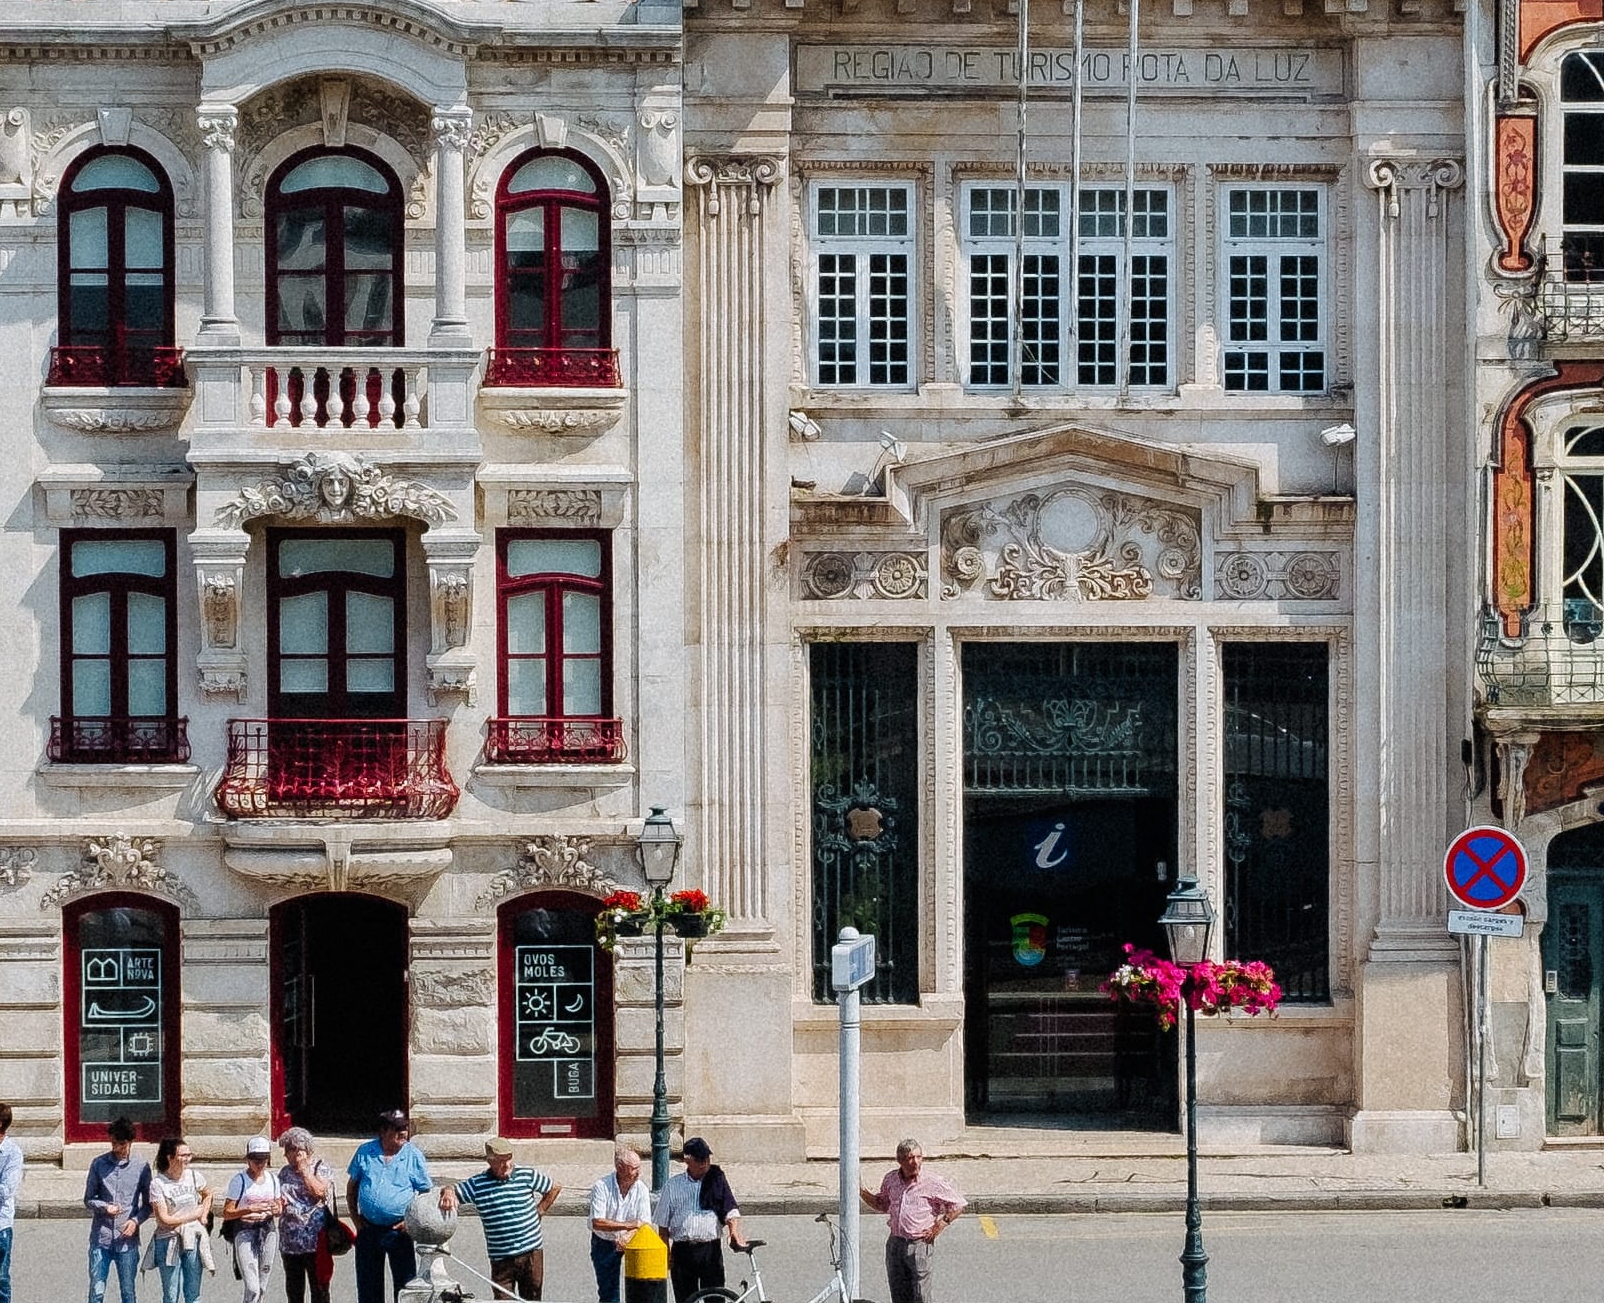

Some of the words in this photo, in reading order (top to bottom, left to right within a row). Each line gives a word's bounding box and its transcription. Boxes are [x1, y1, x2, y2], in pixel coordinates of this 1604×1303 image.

[945, 50, 981, 81] DE
[1204, 52, 1242, 83] DA
[1254, 52, 1312, 83] LUZ
[127, 957, 155, 969] ARTE
[523, 953, 555, 965] OVOS
[127, 969, 155, 980] NOVA
[523, 965, 566, 978] MOLES
[91, 1070, 145, 1083] UNIVER-
[567, 1062, 580, 1093] BUGA
[91, 1083, 138, 1095] SIDADE
